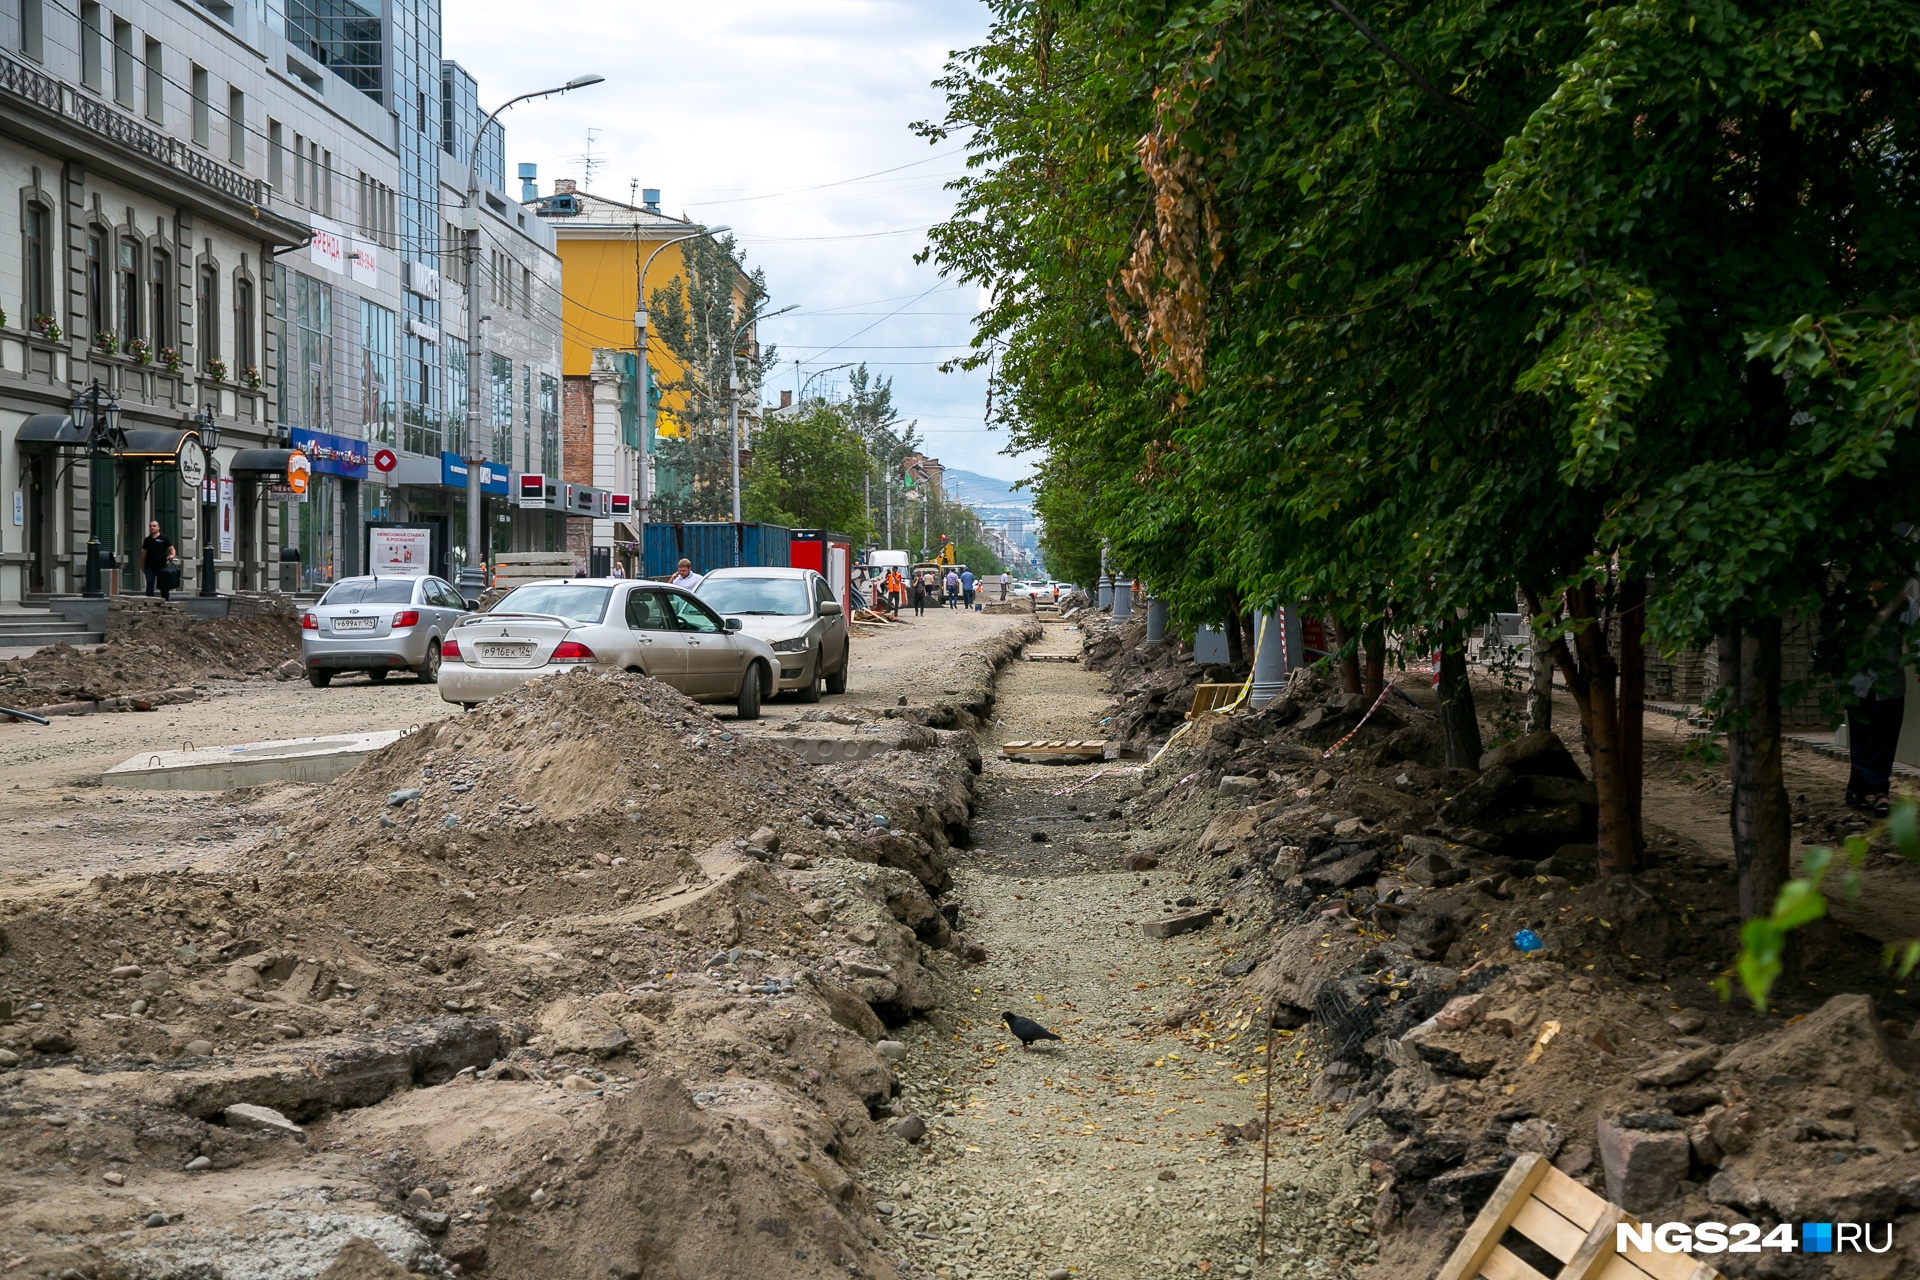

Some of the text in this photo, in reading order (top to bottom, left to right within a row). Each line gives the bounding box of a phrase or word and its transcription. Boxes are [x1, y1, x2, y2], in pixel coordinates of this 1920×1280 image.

[313, 229, 340, 262] АРЕНДА
[271, 484, 293, 492] Mie
[272, 494, 304, 502] ПАРТНЕР
[484, 646, 531, 657] Р916ЕК 124
